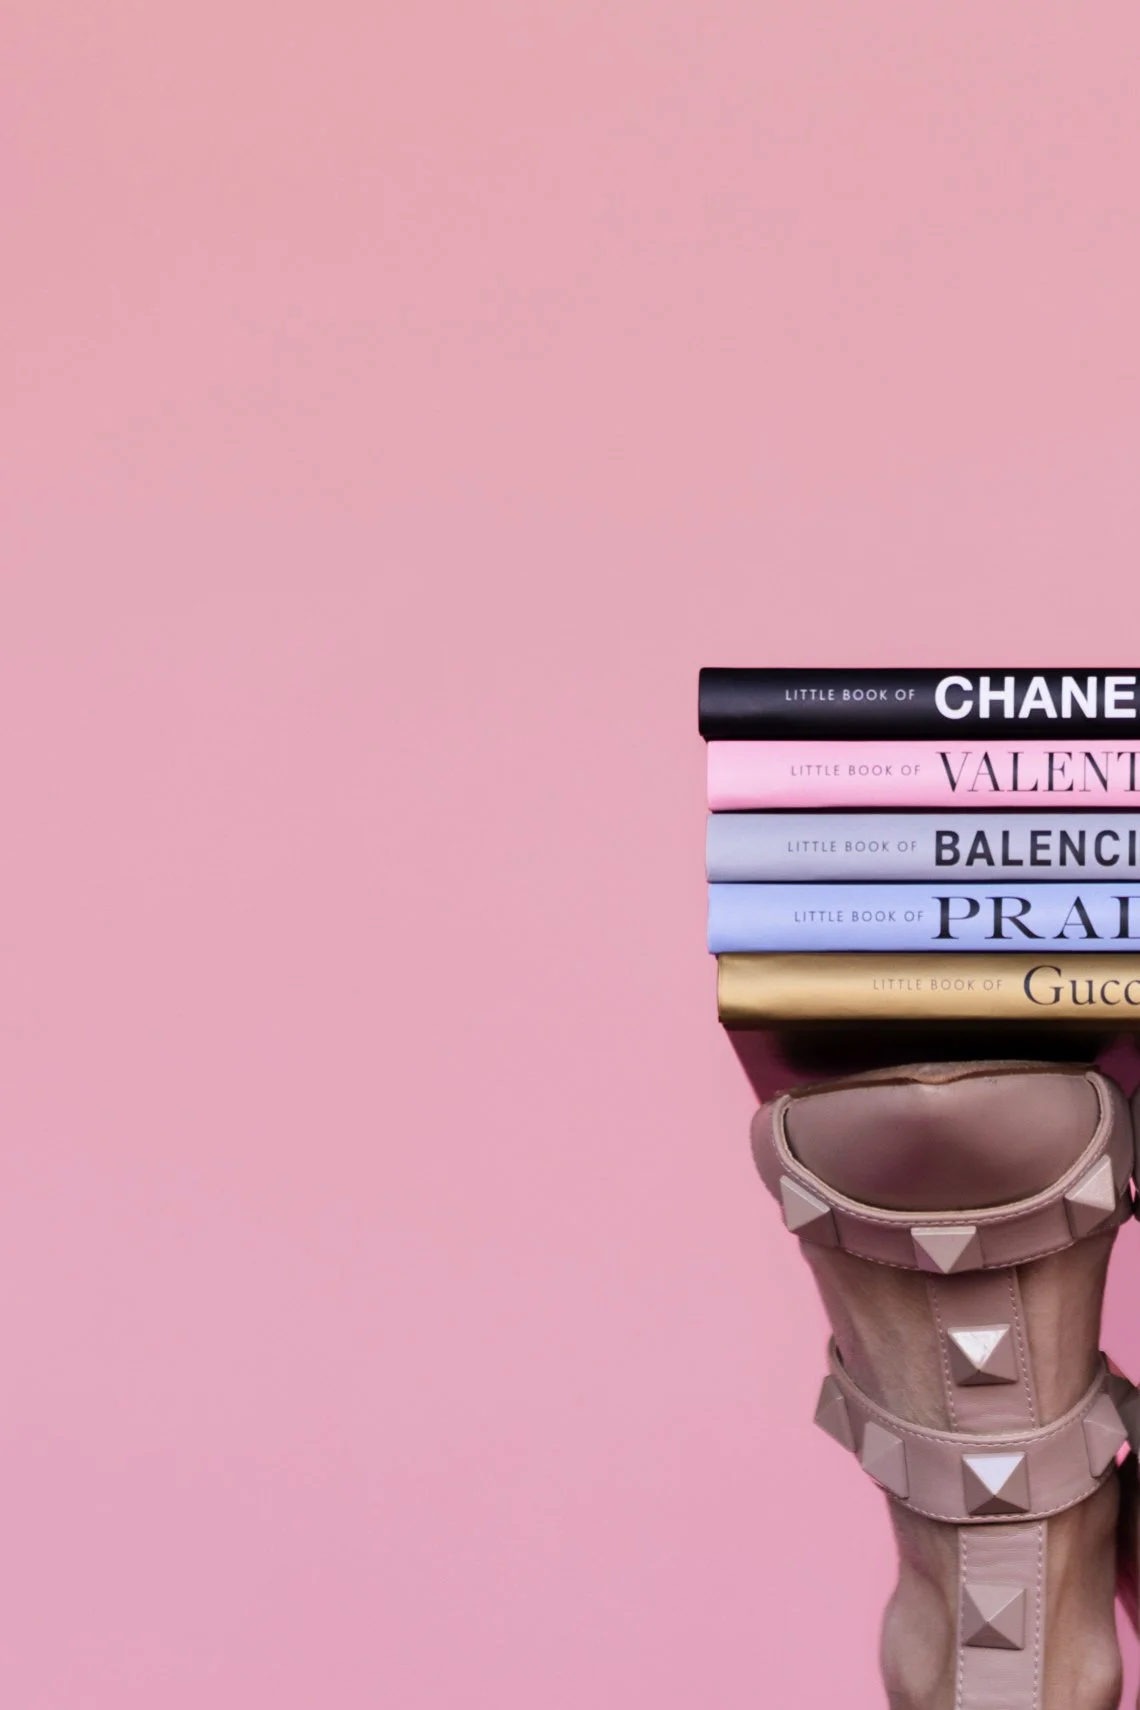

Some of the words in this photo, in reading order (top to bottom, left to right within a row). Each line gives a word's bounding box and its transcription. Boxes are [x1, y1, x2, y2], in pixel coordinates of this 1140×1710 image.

[785, 689, 834, 701] LITTLE
[843, 689, 887, 701] BOOK
[896, 689, 916, 701] OF
[790, 764, 840, 776] LITTLE
[848, 764, 892, 776] BOOK
[901, 764, 921, 776] OF
[788, 841, 836, 852] LITTLE
[845, 841, 890, 852] BOOK
[898, 841, 917, 852] OF
[794, 911, 843, 923] LITTLE
[852, 911, 899, 923] BOOK
[904, 911, 924, 923] OF
[873, 979, 922, 991] LITTLE
[930, 979, 976, 991] BOOK
[983, 979, 1002, 991] OF
